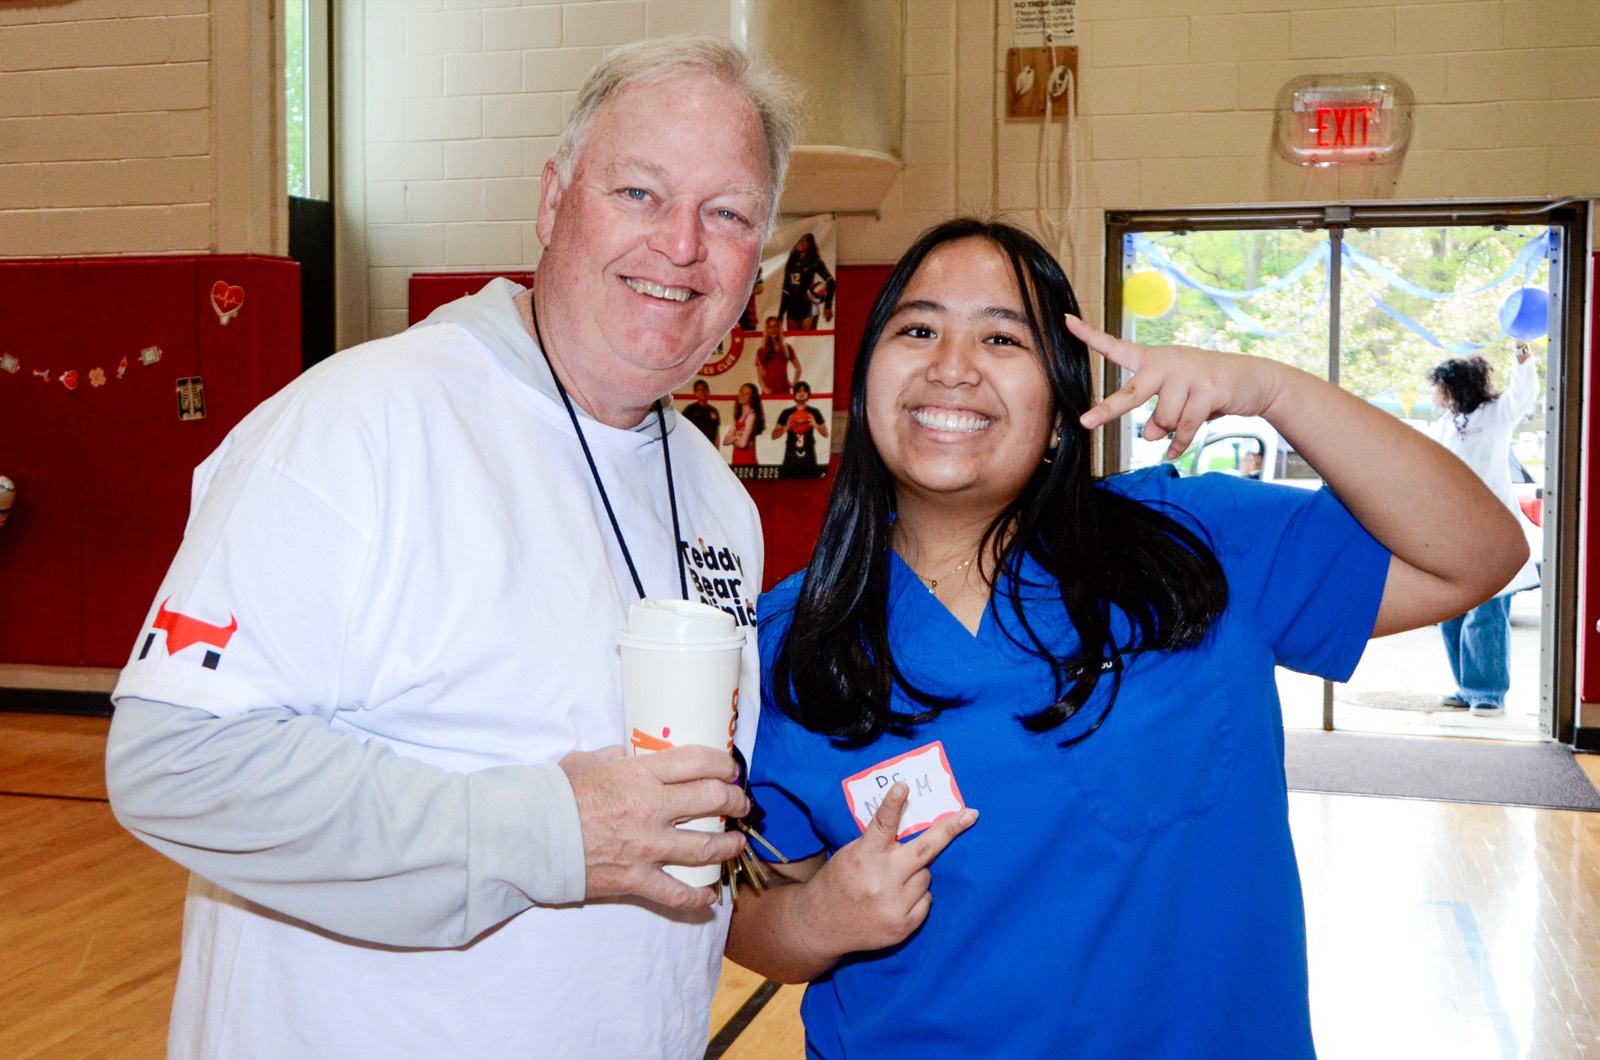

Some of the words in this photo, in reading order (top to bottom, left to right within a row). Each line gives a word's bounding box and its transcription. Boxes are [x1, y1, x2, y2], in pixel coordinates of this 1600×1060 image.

[1316, 107, 1374, 147] EXIT
[717, 354, 736, 371] CLUB
[680, 540, 744, 578] Teddy
[688, 567, 742, 599] Bear
